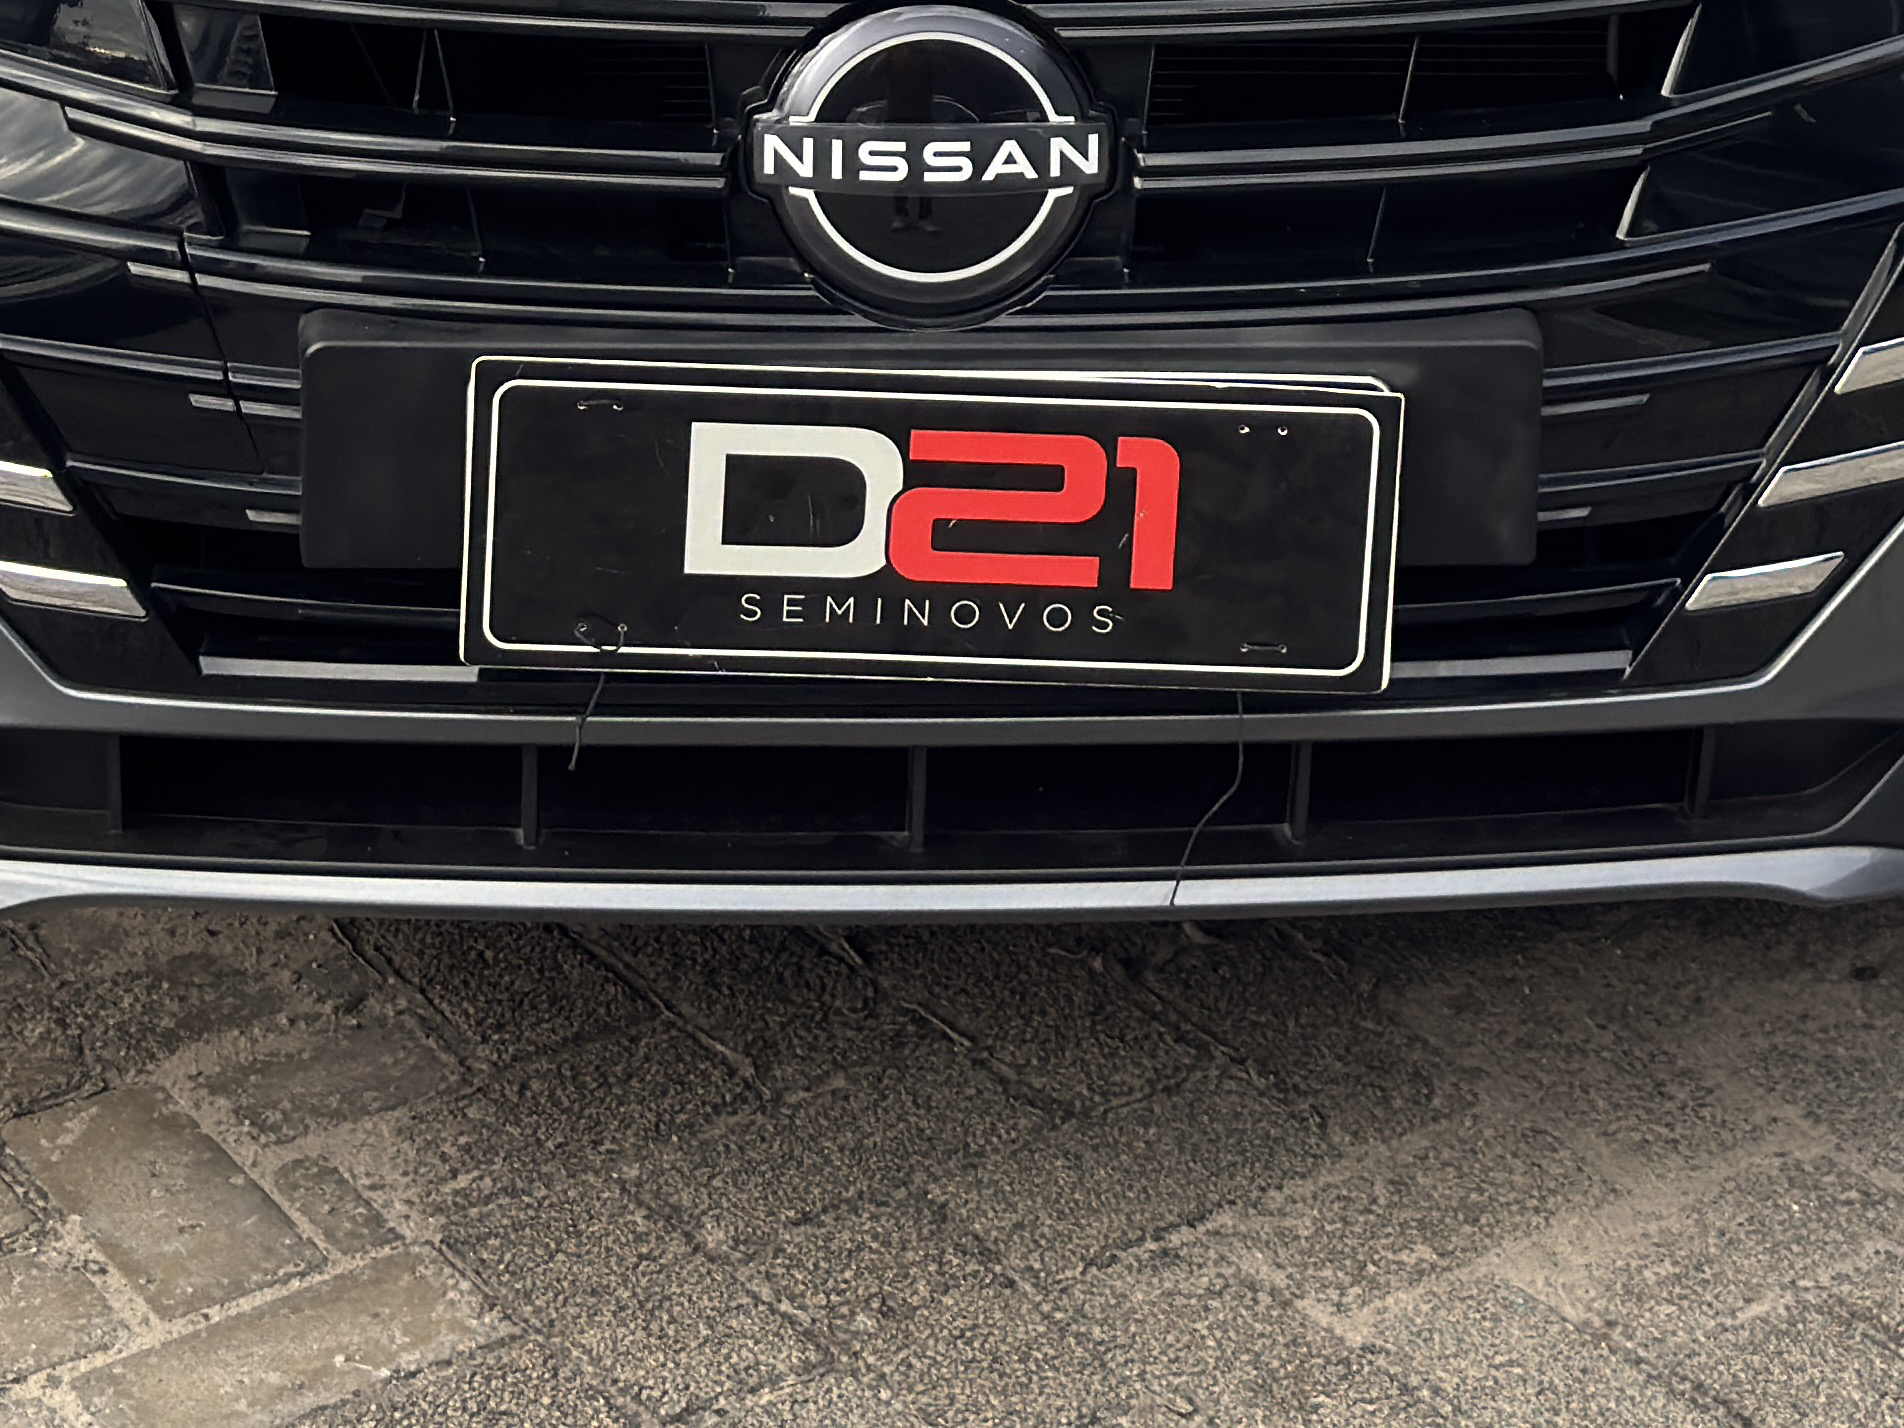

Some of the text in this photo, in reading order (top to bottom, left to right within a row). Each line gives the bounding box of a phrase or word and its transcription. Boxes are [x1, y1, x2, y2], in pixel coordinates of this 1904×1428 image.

[762, 133, 1100, 182] NISSAN
[684, 422, 1181, 590] D21
[739, 593, 1116, 634] SEMINOVOS
